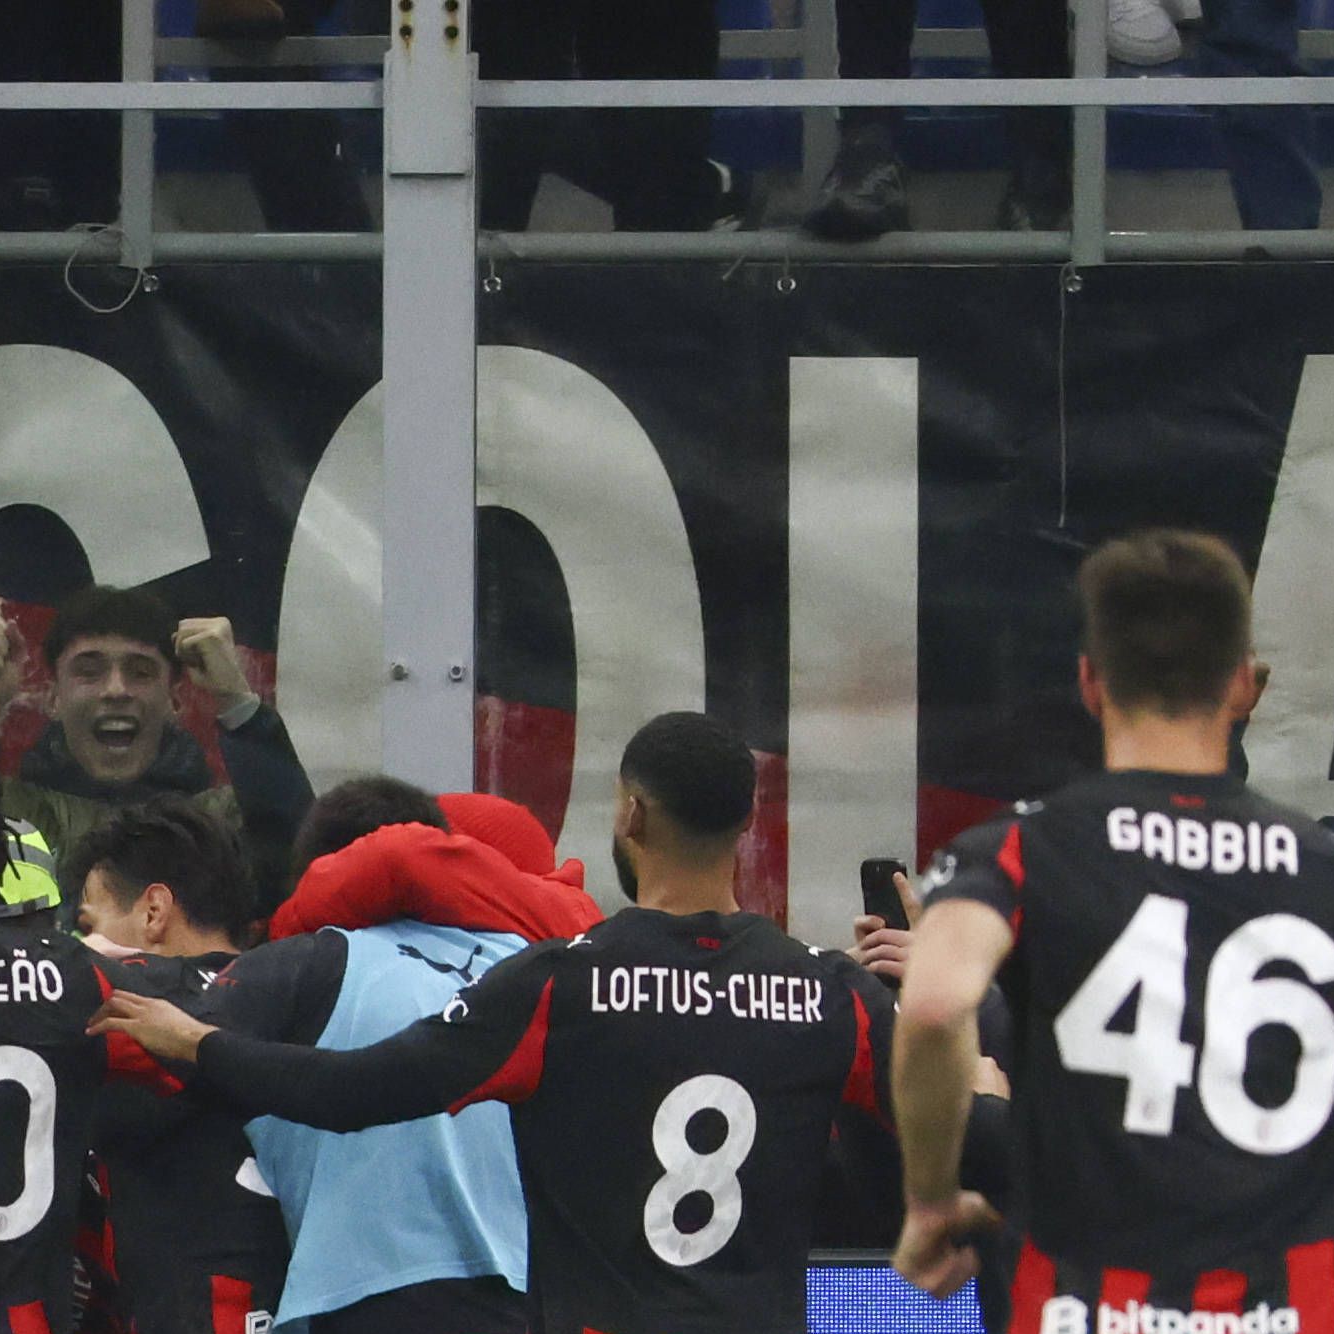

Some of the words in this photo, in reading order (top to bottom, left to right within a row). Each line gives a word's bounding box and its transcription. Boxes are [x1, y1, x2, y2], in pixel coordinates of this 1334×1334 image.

[1106, 807, 1299, 876] GABBIA
[591, 966, 824, 1024] LOFTUS-CHEEK
[643, 1074, 757, 1268] 8
